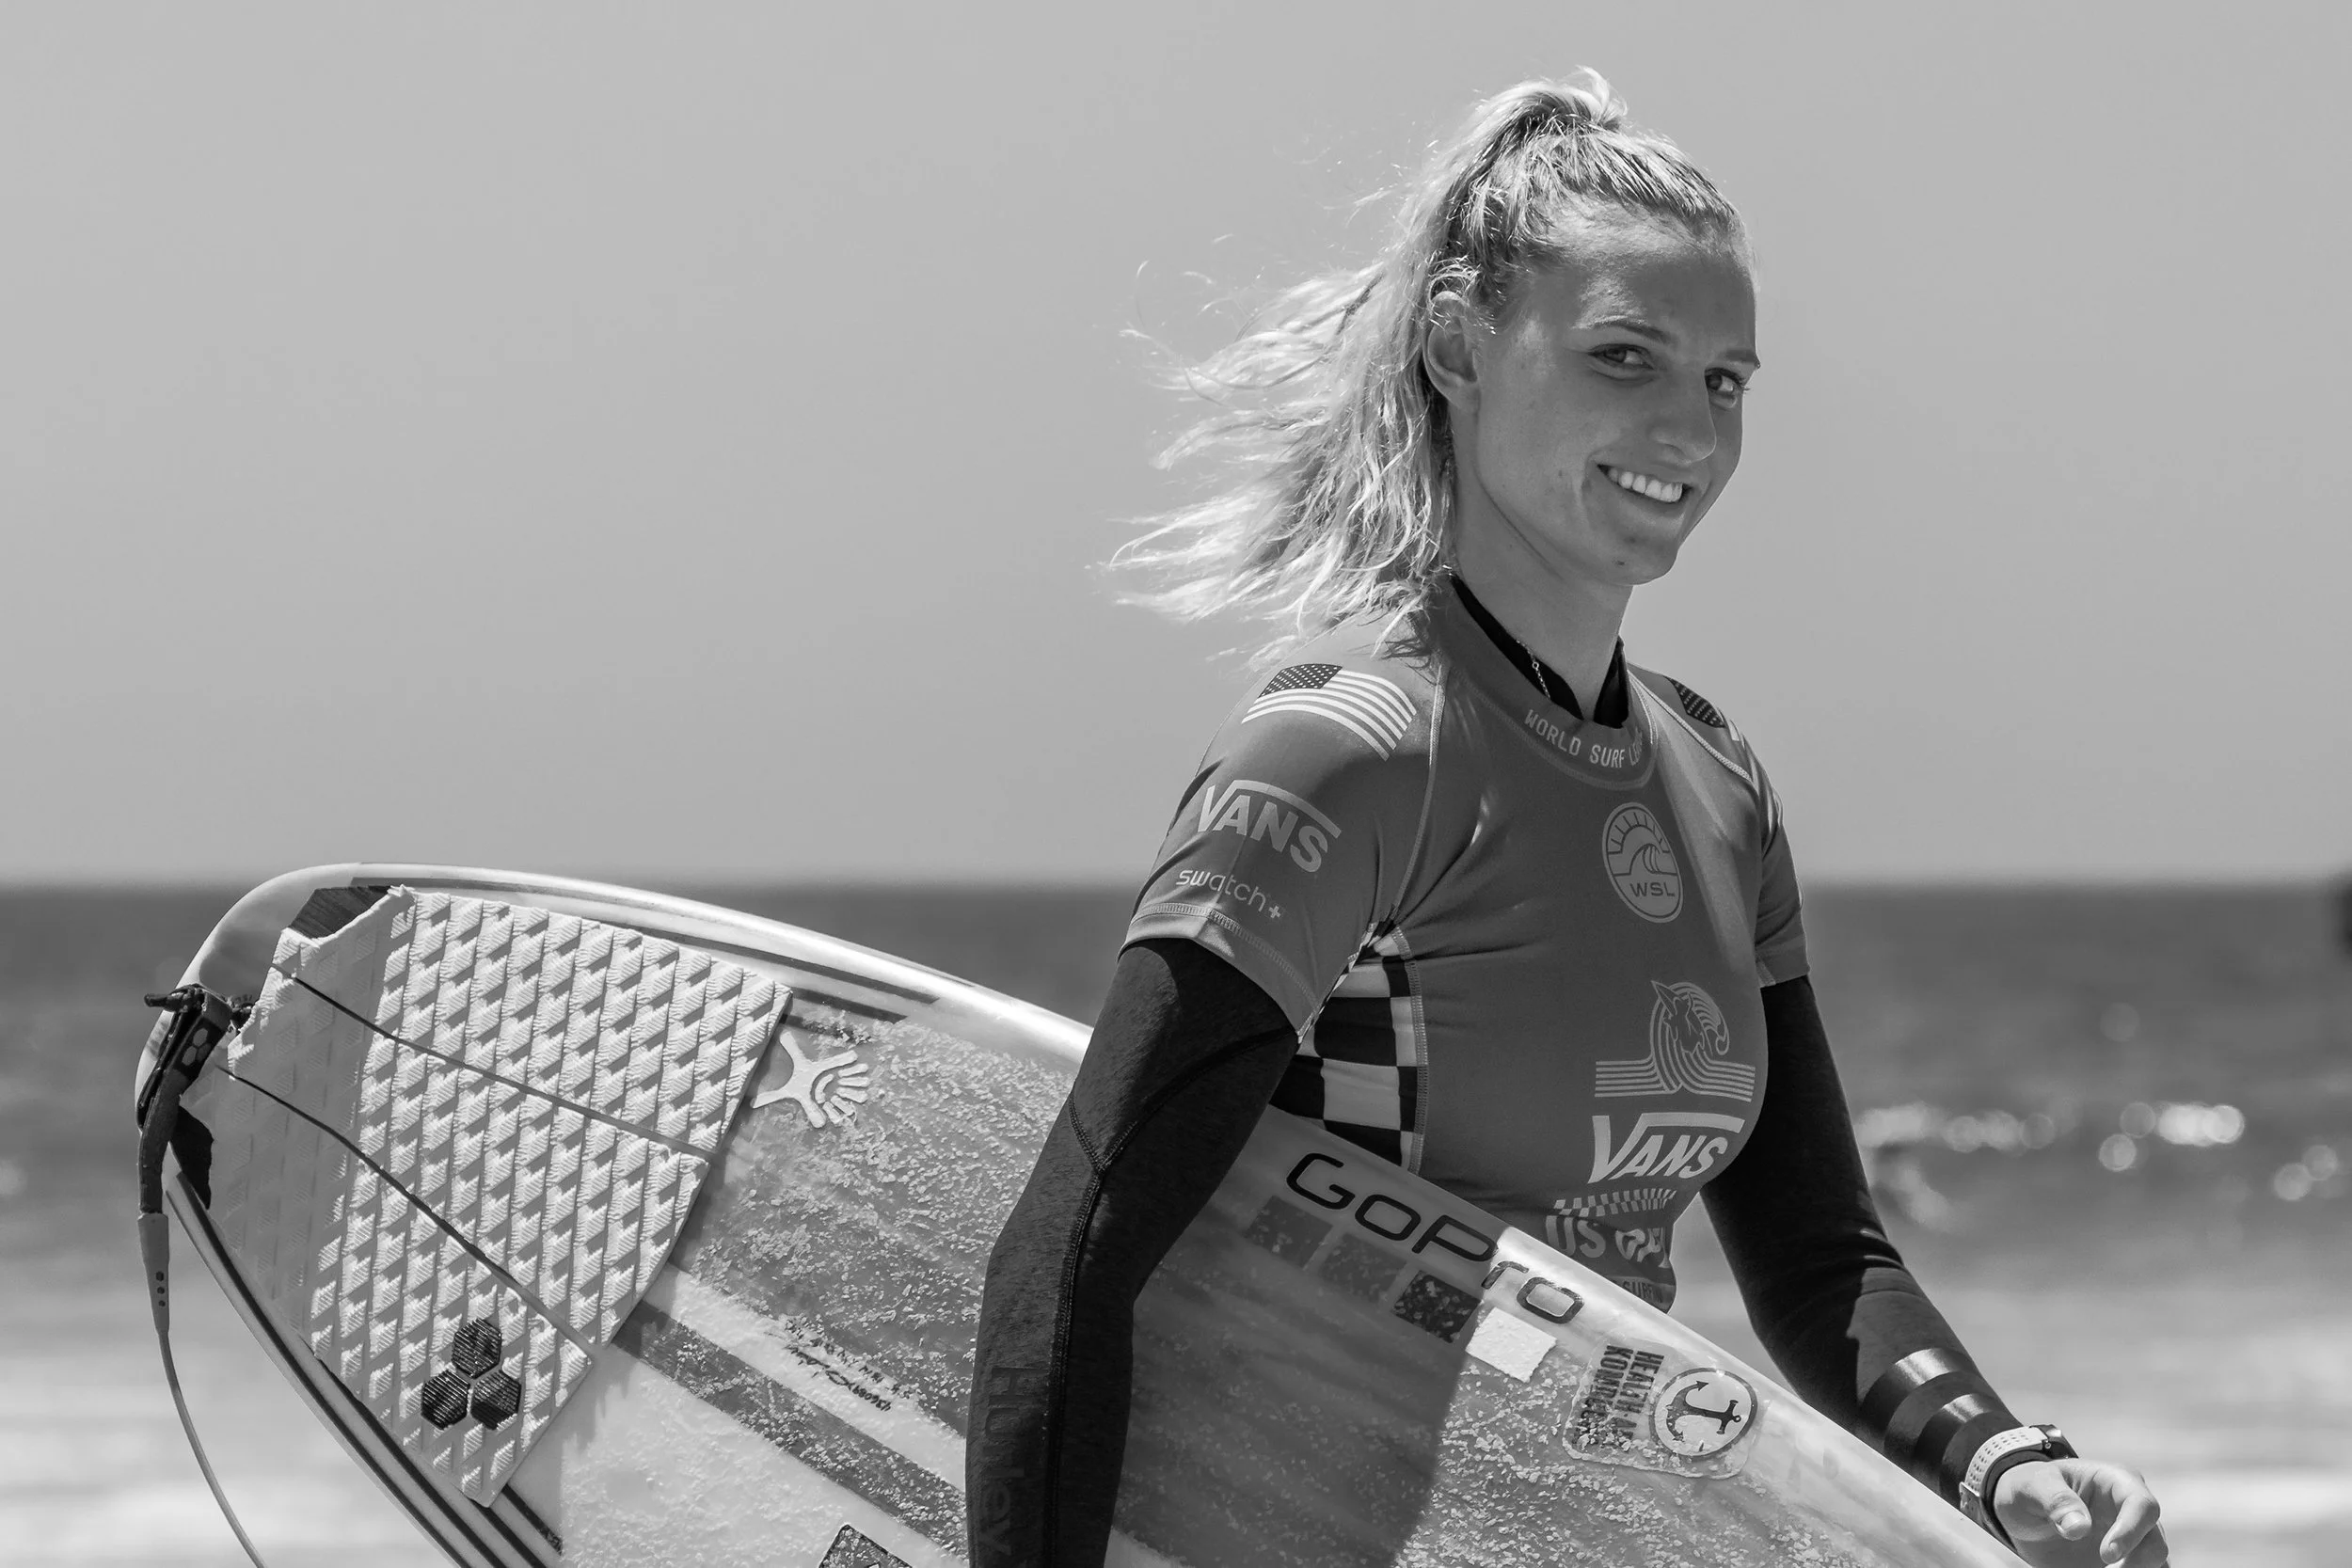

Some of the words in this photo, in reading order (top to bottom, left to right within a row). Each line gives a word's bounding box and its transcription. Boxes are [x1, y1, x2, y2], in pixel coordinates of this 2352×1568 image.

[1523, 709, 1582, 757] WORLD
[1589, 744, 1626, 768] SURF
[1197, 779, 1342, 873] VANS
[1629, 881, 1677, 898] WSL
[1586, 1112, 1746, 1184] VANS
[1545, 1215, 1607, 1259] US
